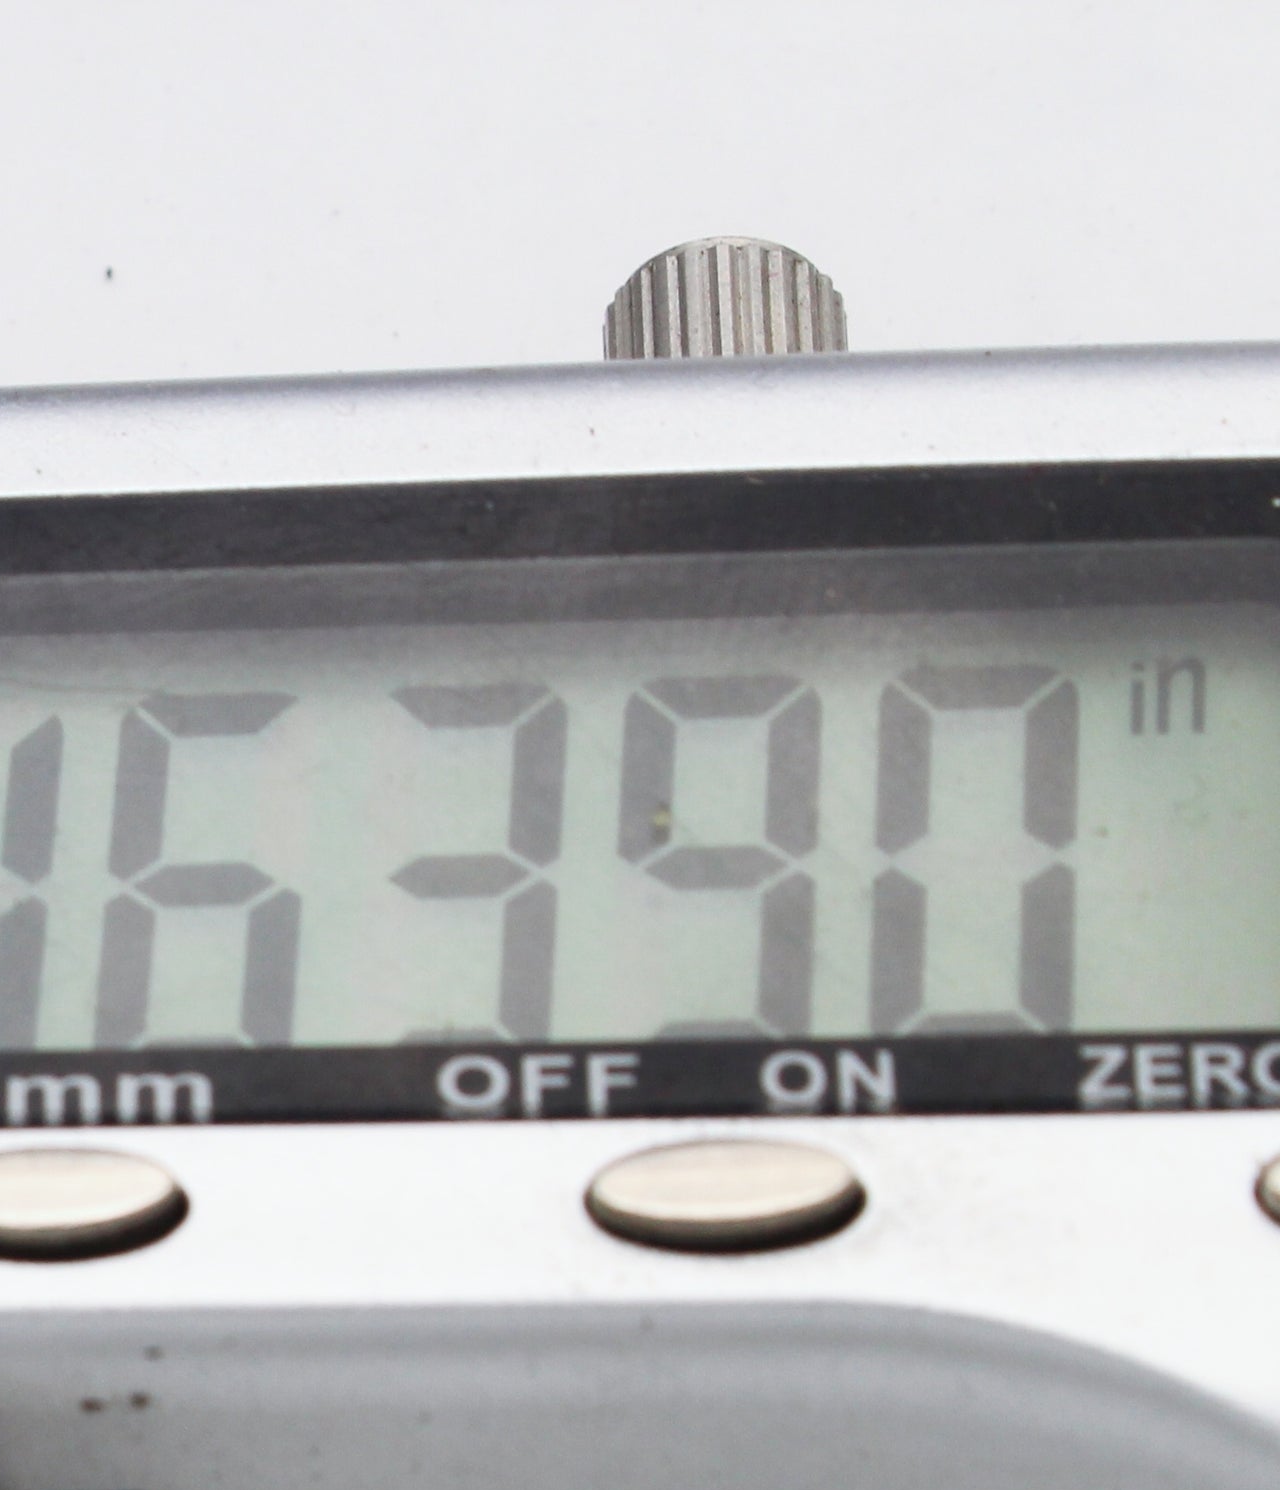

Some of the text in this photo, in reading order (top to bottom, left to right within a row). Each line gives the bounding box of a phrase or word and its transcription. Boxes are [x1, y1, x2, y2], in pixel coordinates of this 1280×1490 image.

[1130, 655, 1206, 736] in
[438, 1052, 640, 1112] OFF
[760, 1049, 896, 1108] ON
